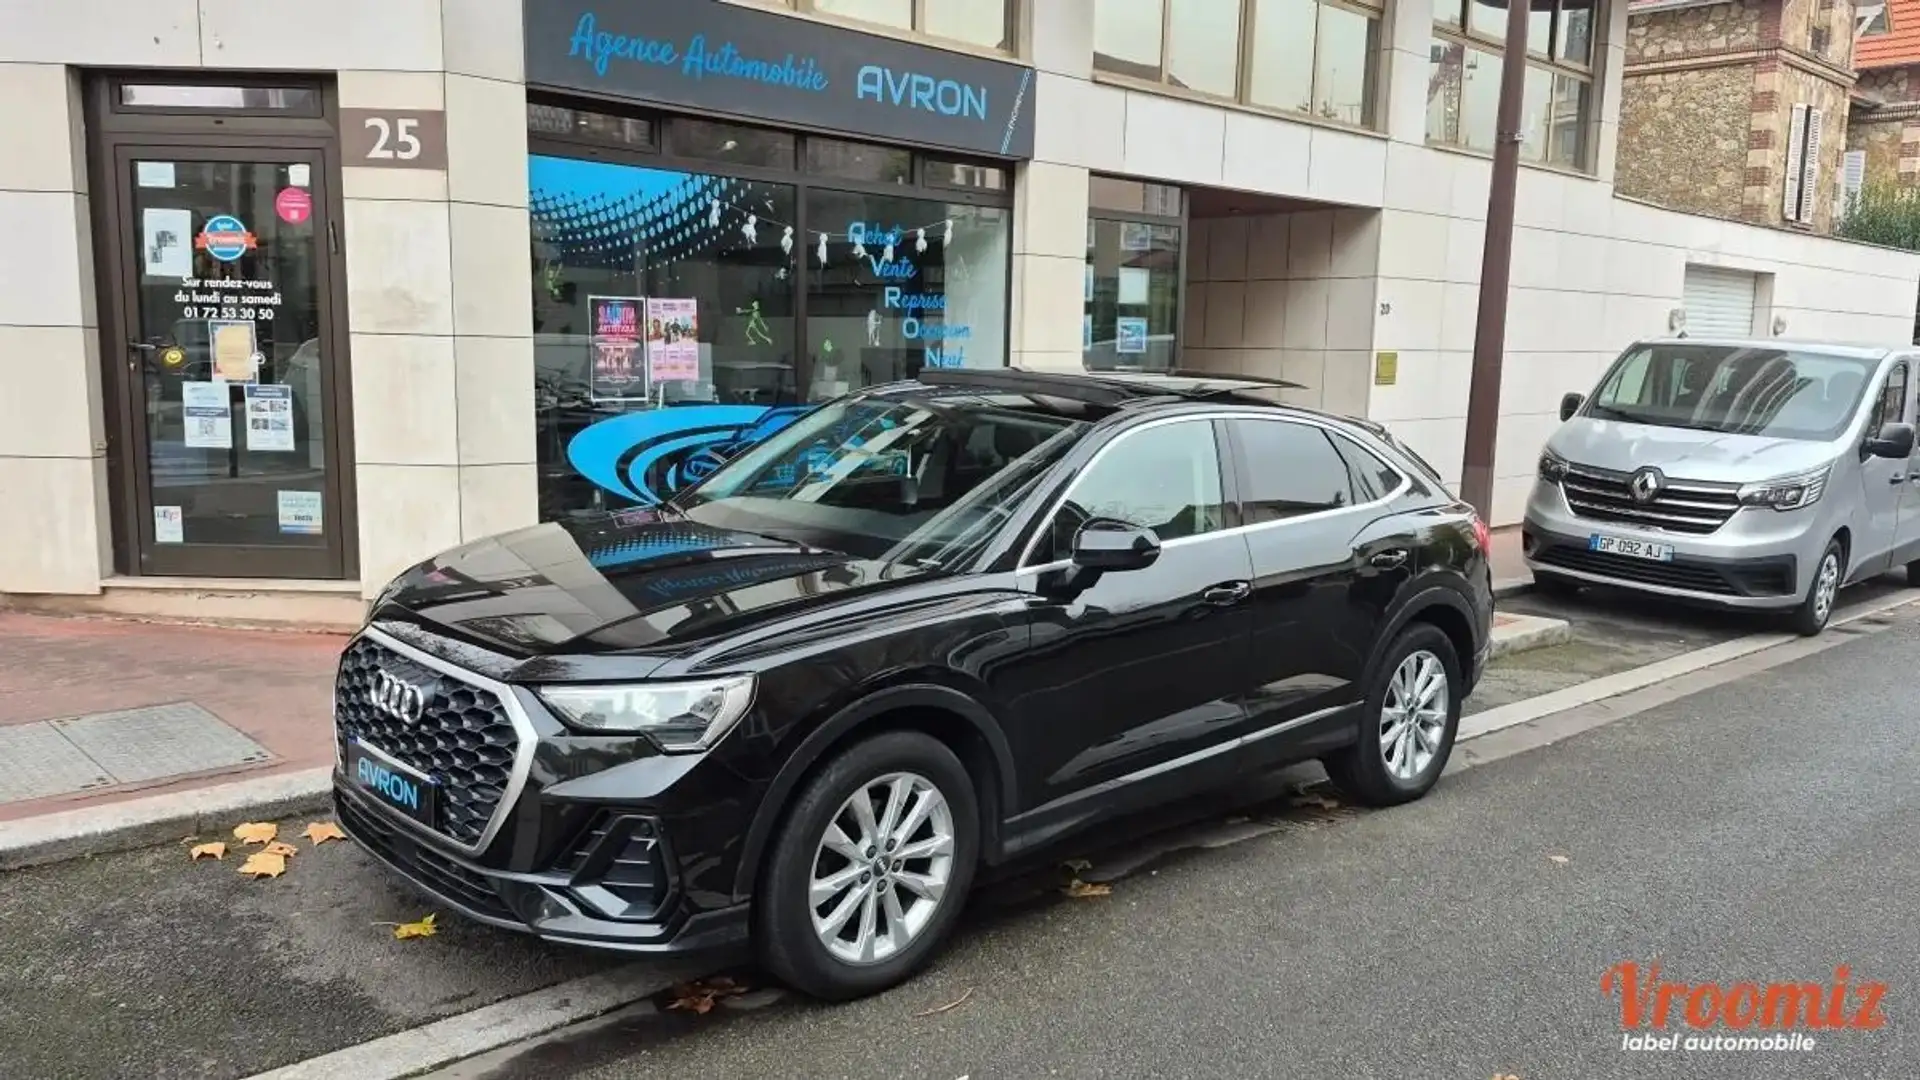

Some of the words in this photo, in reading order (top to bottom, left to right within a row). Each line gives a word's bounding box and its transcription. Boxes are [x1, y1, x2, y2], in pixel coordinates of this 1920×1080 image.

[568, 12, 679, 76] Agence
[682, 34, 828, 90] Automobile
[857, 65, 987, 120] AVRON
[364, 117, 421, 160] 25
[848, 221, 902, 246] Achat
[869, 254, 918, 279] Vente
[182, 276, 201, 287] Sur
[204, 276, 273, 289] rendez-vous
[174, 290, 190, 302] du
[192, 290, 221, 303] lundi
[223, 295, 238, 303] au
[241, 292, 282, 305] samedi
[885, 286, 949, 317] Reprise
[184, 307, 198, 318] 01
[202, 307, 218, 318] 72
[221, 307, 236, 319] 53
[240, 308, 255, 319] 30
[258, 308, 274, 320] 50
[1618, 540, 1641, 555] 092
[1645, 544, 1662, 558] AJ
[358, 756, 418, 811] AVRON
